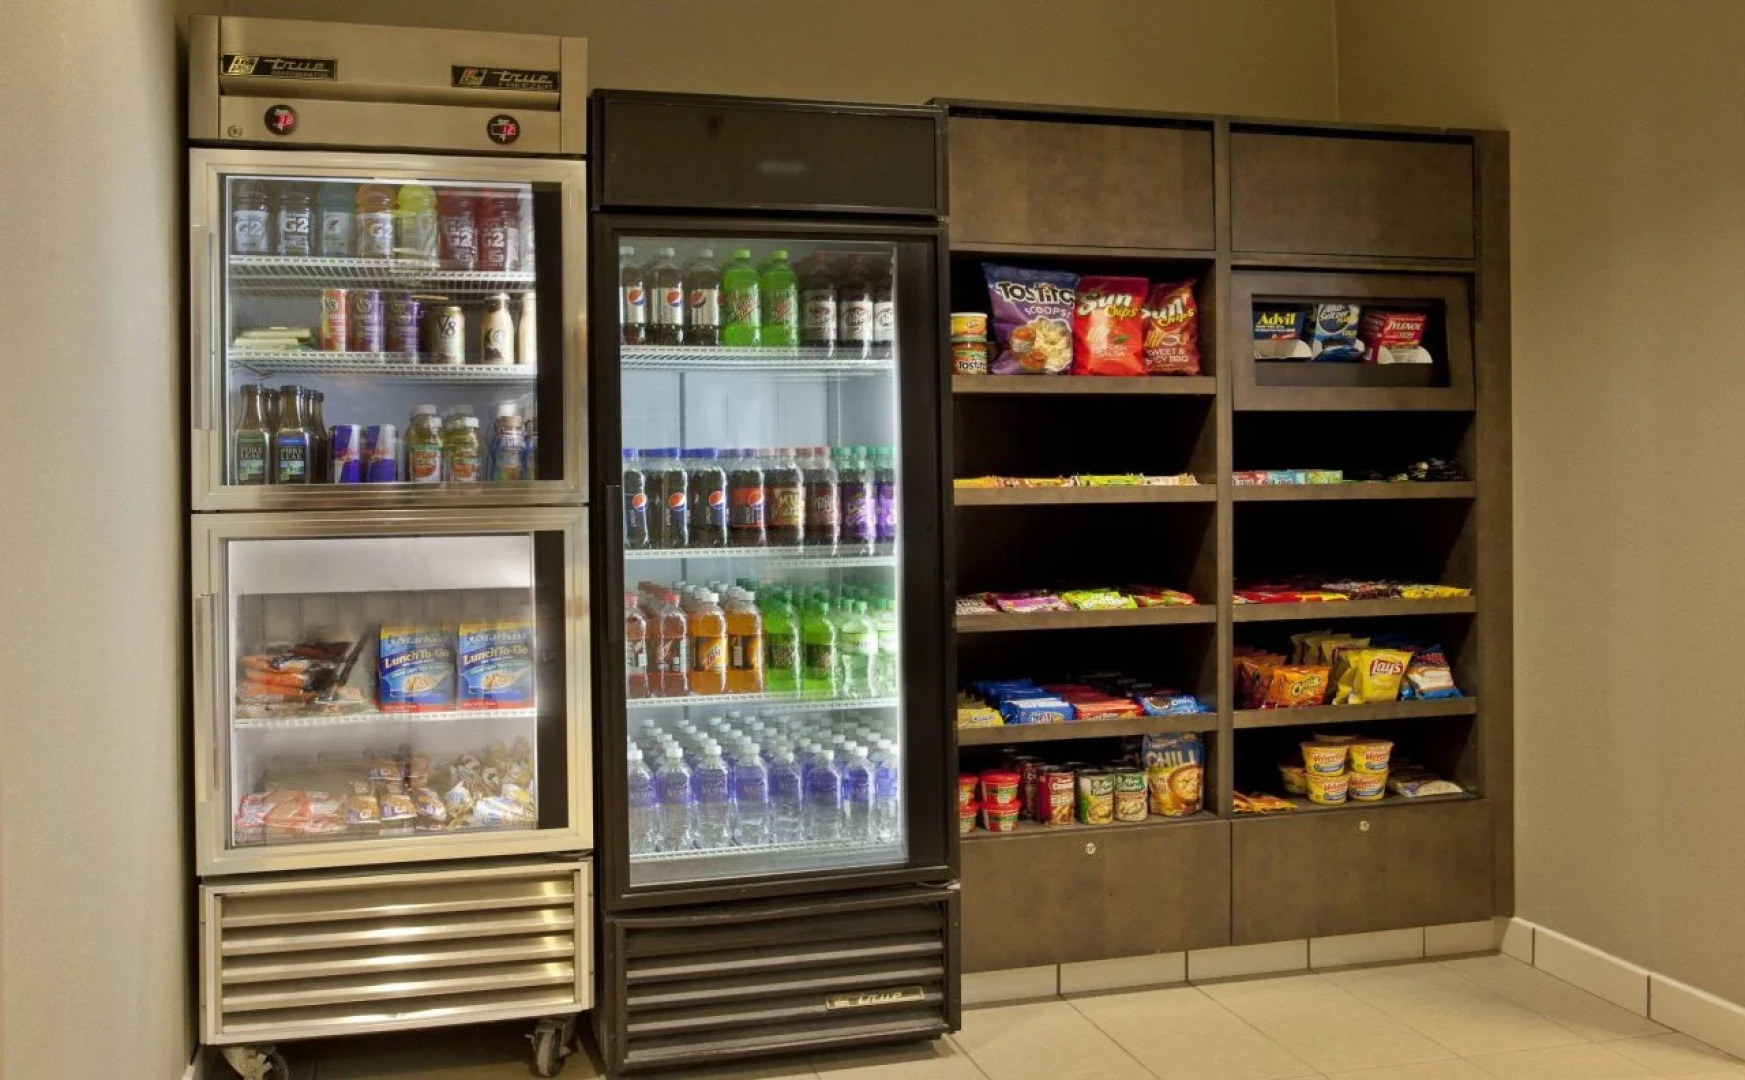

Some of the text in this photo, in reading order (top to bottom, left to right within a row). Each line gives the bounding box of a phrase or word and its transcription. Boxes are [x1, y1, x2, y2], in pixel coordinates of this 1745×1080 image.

[263, 58, 330, 71] true
[492, 70, 552, 83] true
[285, 217, 309, 233] G2
[994, 281, 1076, 307] TOSTiTO
[1078, 293, 1132, 316] Sun
[439, 314, 455, 337] V8
[1256, 313, 1296, 326] Advil
[384, 650, 418, 669] Lunch
[463, 646, 498, 666] Lunch
[1371, 660, 1402, 675] Lay's
